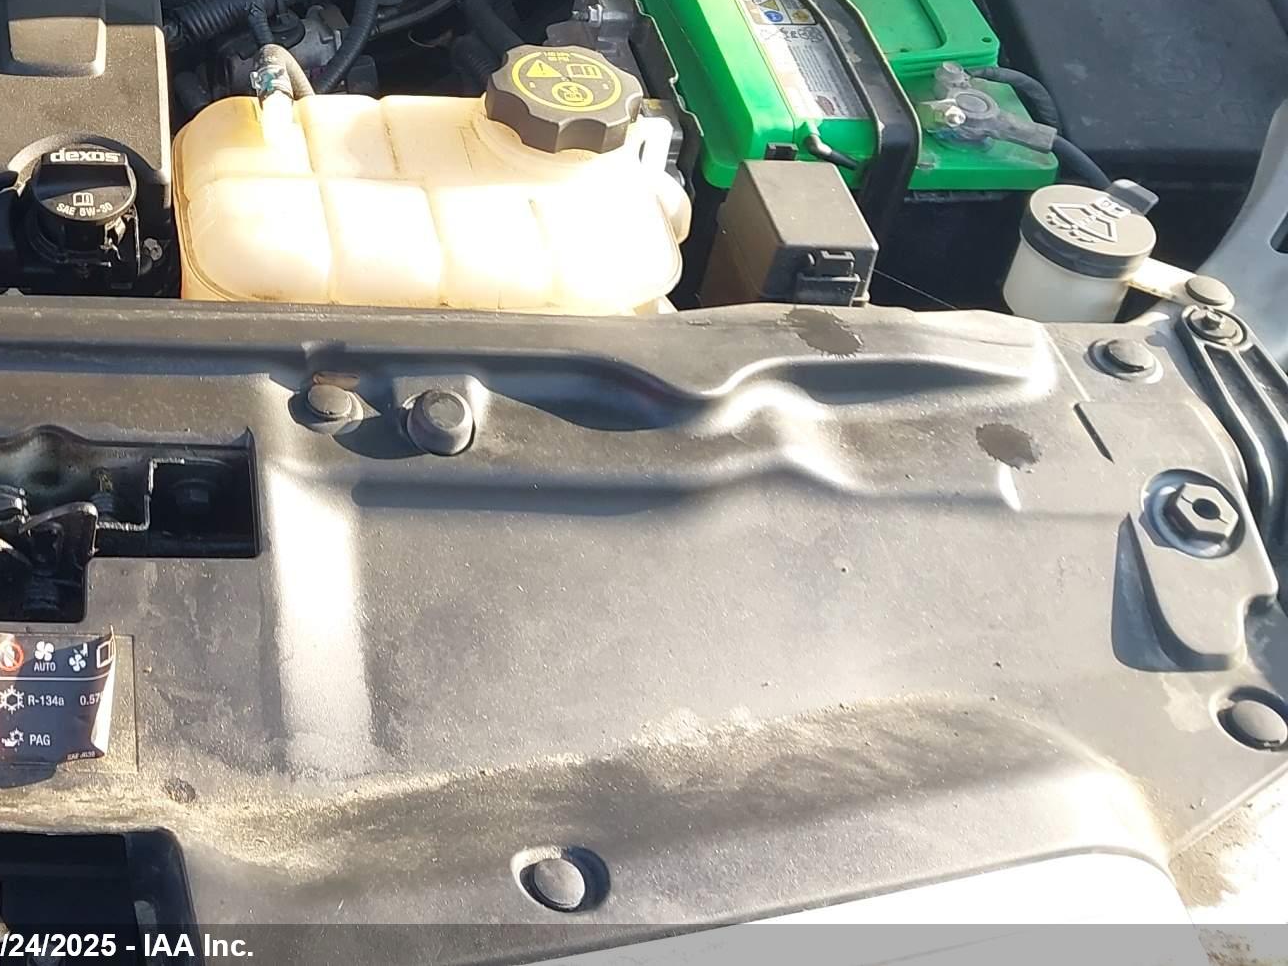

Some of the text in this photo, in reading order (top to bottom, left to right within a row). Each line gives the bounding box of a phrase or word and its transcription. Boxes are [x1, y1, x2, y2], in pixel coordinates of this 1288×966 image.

[49, 147, 121, 163] dexos
[56, 202, 114, 217] SAE 5W-30
[33, 661, 56, 672] AUTO
[27, 692, 103, 707] R-134a 0.57
[29, 734, 51, 747] PAG
